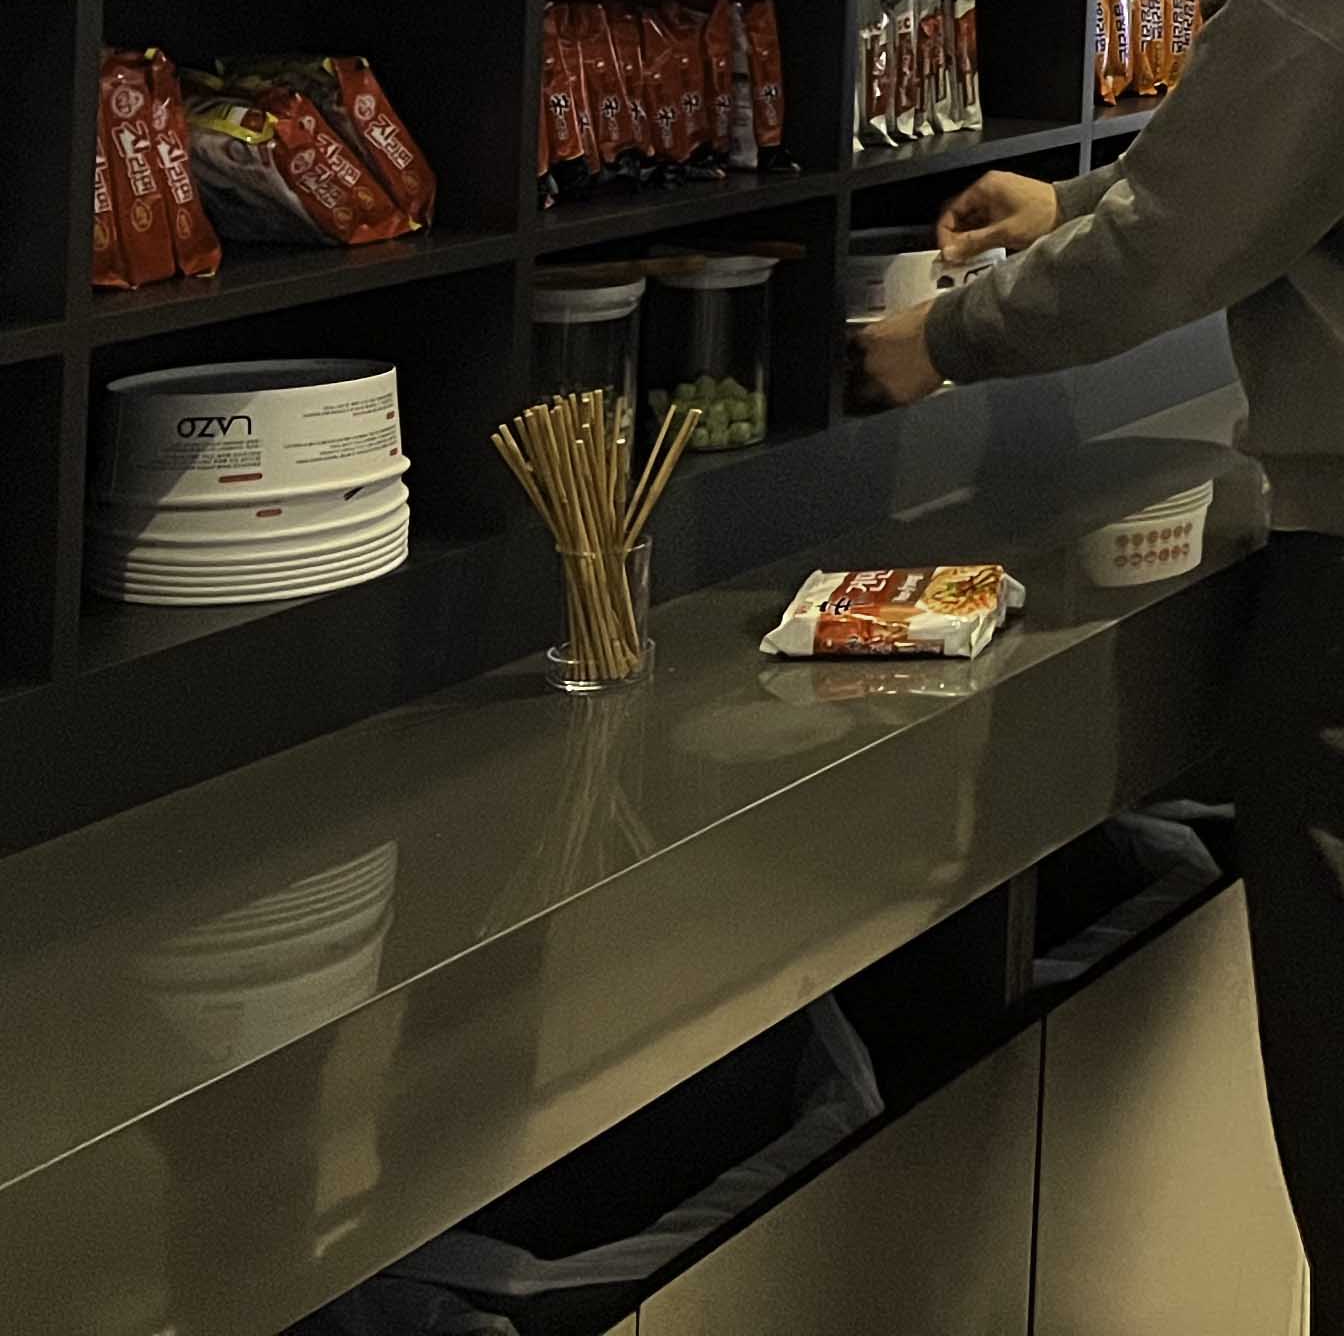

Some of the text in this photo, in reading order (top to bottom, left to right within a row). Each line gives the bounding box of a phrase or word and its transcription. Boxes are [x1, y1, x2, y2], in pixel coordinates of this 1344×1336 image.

[112, 120, 157, 196] 진라면
[155, 129, 193, 205] 진라면
[364, 113, 413, 170] 진라면
[177, 415, 252, 438] LAZO
